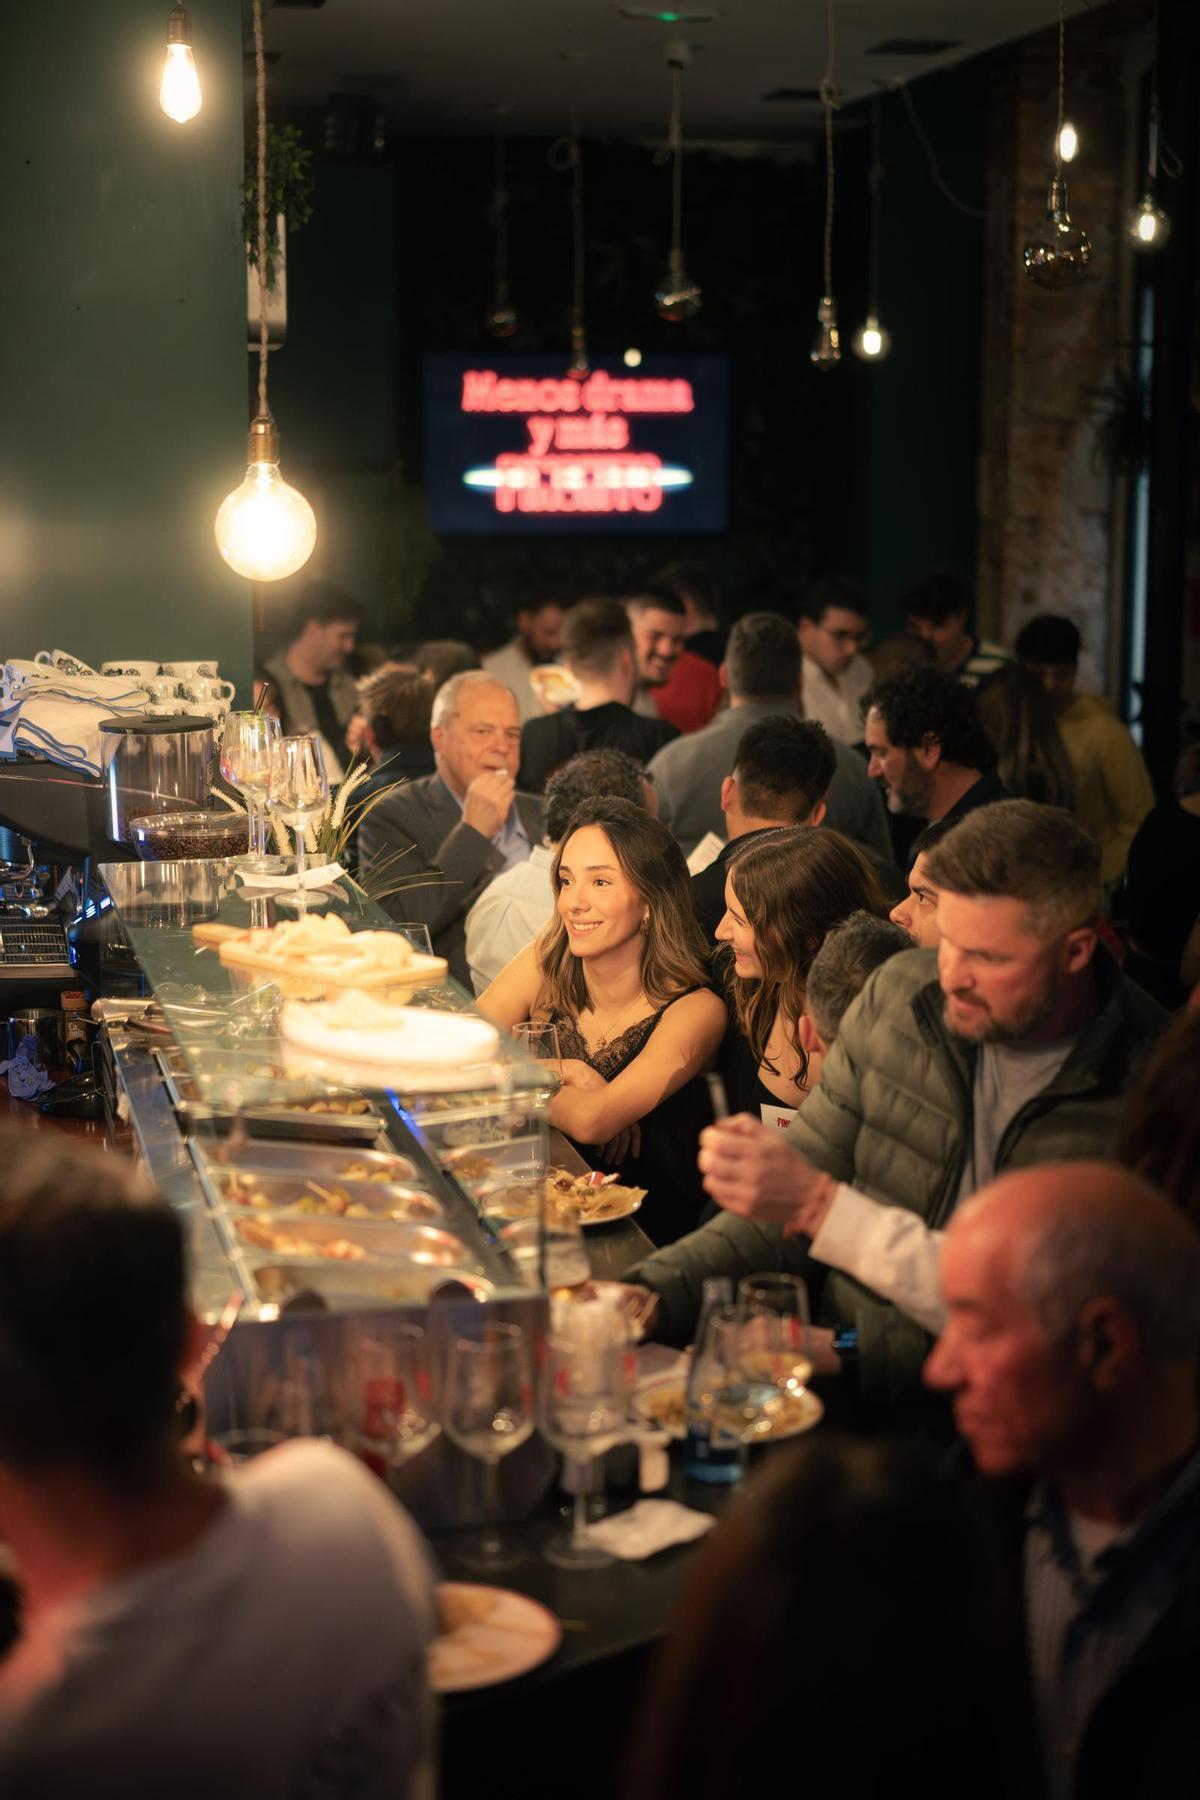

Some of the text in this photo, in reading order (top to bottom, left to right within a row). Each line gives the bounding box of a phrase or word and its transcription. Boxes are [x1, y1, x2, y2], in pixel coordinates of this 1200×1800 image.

[461, 369, 694, 411] Menos drama
[526, 414, 555, 456] y
